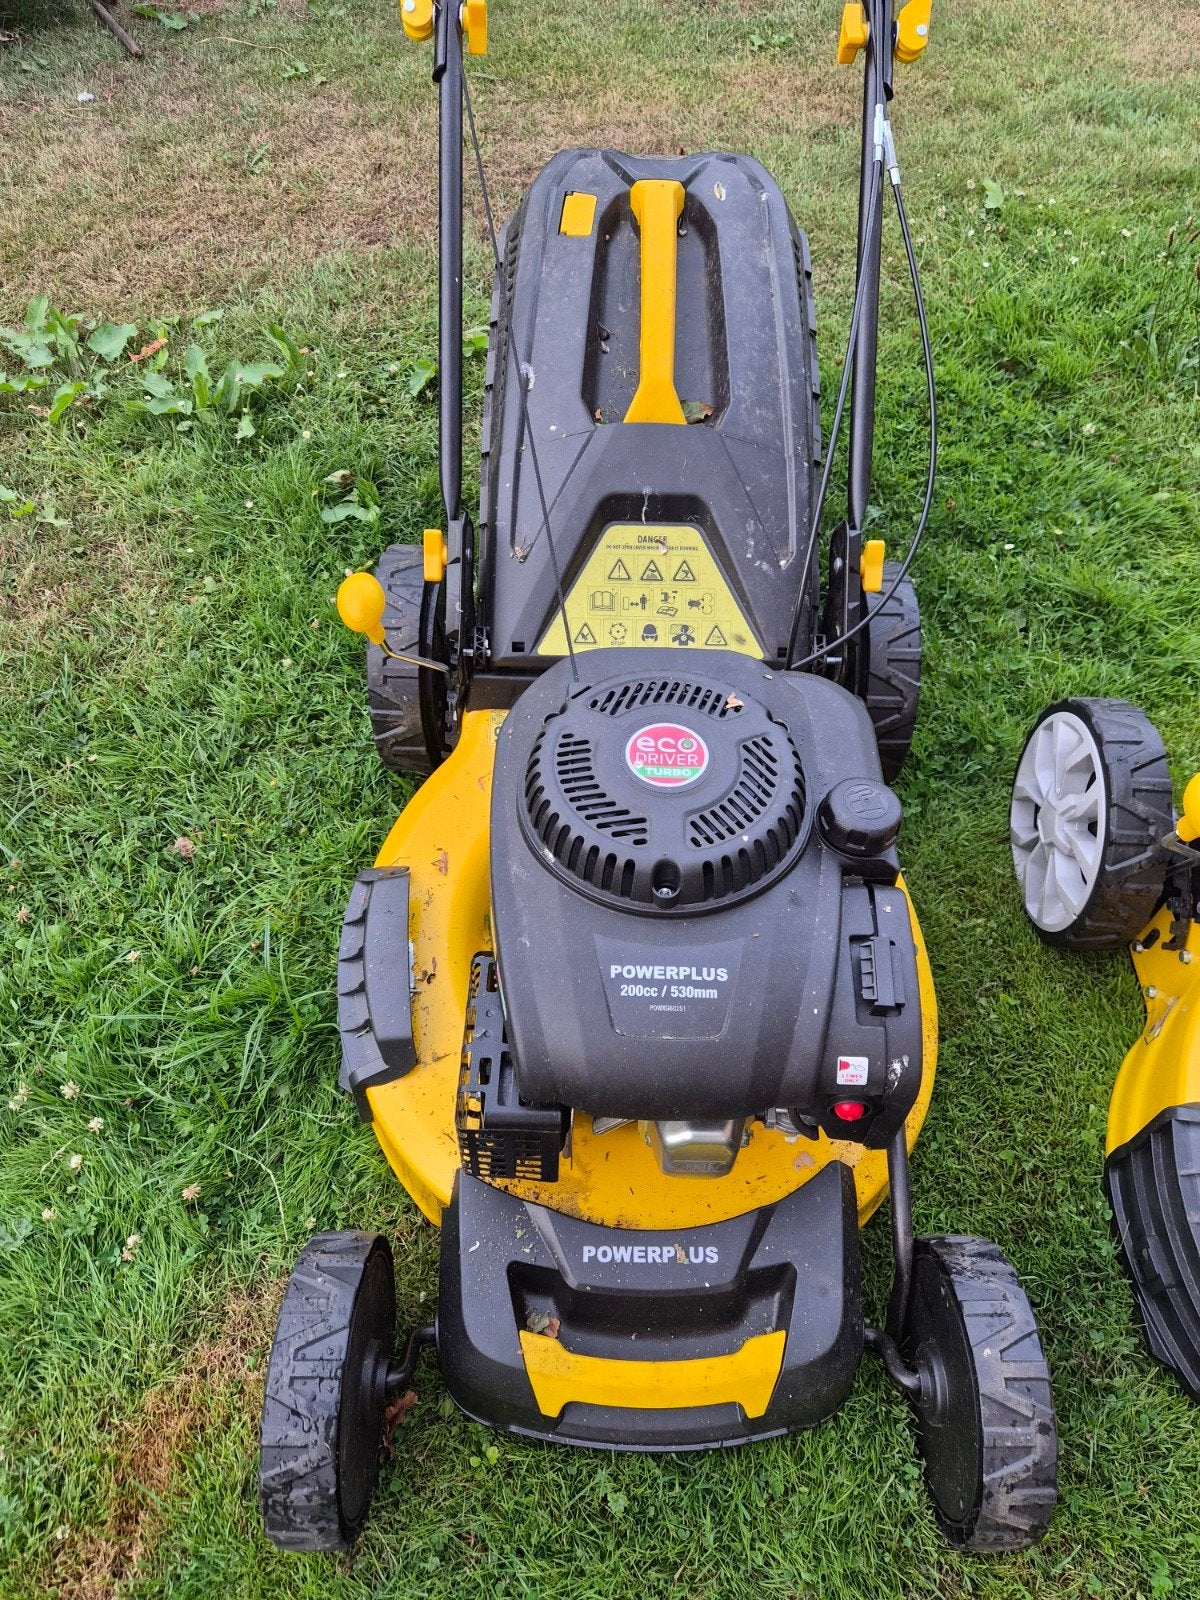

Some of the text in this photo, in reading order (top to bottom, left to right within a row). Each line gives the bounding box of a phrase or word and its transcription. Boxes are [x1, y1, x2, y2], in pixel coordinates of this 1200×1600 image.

[637, 535, 668, 544] DANGER
[635, 752, 699, 766] DRIVER
[644, 767, 692, 777] TURBO
[610, 964, 729, 981] POWERPLUS
[620, 984, 718, 999] 200cc / 530mm
